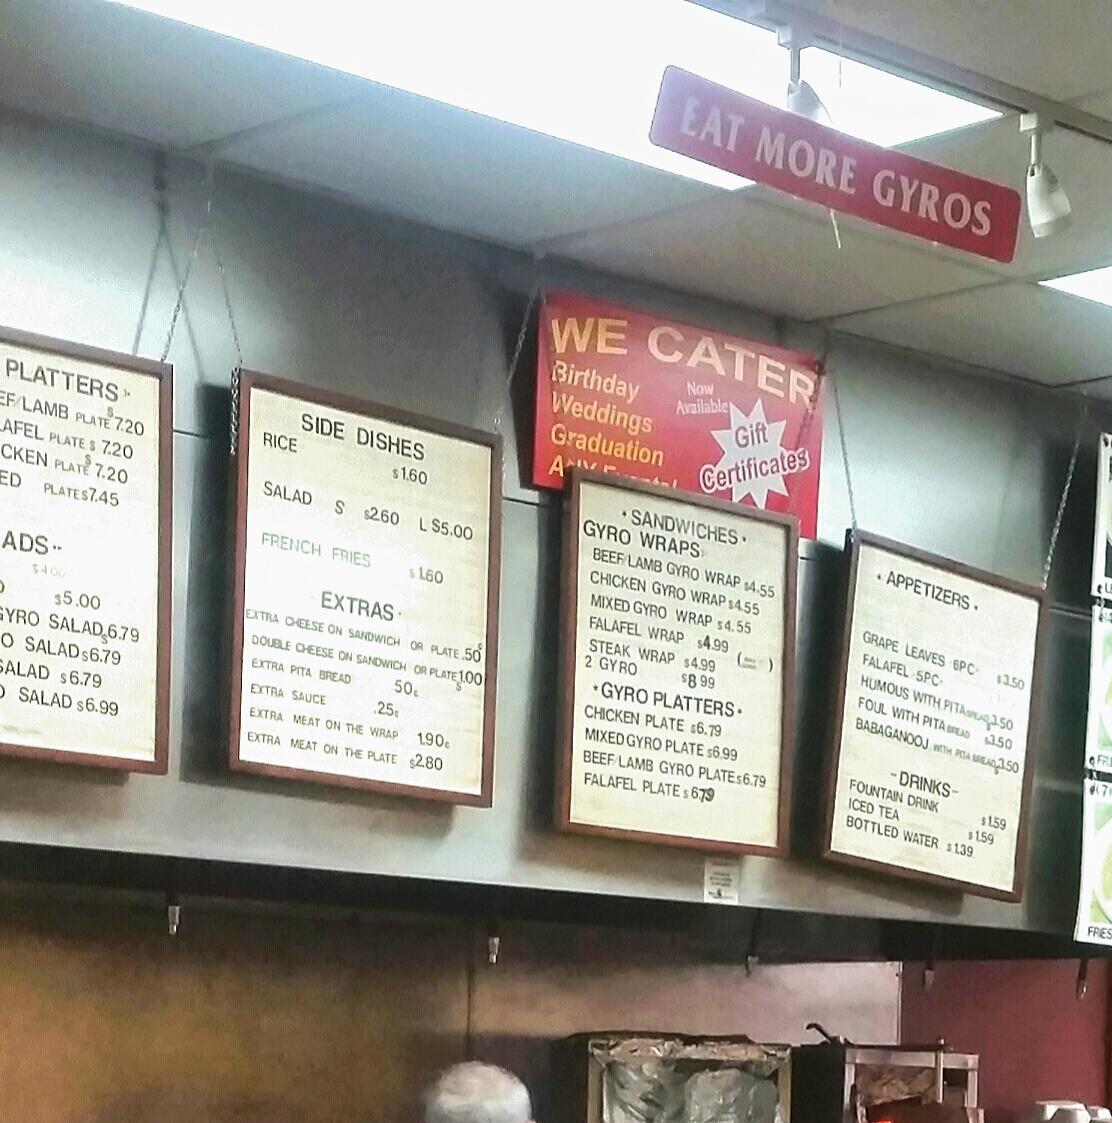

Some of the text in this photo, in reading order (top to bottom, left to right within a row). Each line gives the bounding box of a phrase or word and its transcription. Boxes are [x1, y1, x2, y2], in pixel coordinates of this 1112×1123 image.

[679, 97, 992, 237] EAT MORE GYROS
[551, 318, 819, 406] WE CATER
[6, 358, 118, 402] PLATTERS
[552, 360, 640, 404] Birthday
[687, 382, 714, 395] Now
[552, 392, 652, 434] Weddings
[676, 399, 728, 415] Available
[263, 432, 297, 452] RICE
[302, 414, 424, 460] SIDE DISHES
[550, 423, 664, 466] Graduation
[735, 422, 768, 449] Gift
[701, 448, 809, 491] Certificates
[264, 481, 312, 505] SALAD
[583, 520, 700, 558] GYRO WRAPS
[631, 509, 738, 545] SANDWICHES
[262, 533, 370, 568] FRENCH FRIES
[591, 571, 726, 606] CHICKEN GYRO WRAP
[667, 562, 699, 581] GYRO
[705, 570, 741, 587] WRAP
[887, 571, 970, 610] APPETIZERS
[321, 591, 394, 621] EXTRAS
[591, 594, 712, 627] MIXED GYRO WRAP
[49, 614, 103, 636] SALAD
[246, 609, 459, 659] EXTRA ON SANDWICH PLATE
[590, 617, 684, 644] FALAFEL WRAP
[25, 637, 79, 658] SALAD
[252, 635, 291, 651] DOUBLE
[589, 639, 675, 664] STEAK WRAP
[863, 631, 945, 667] GRAPE LEAVES
[252, 659, 351, 683] EXTRA PITA BREAD
[585, 655, 637, 676] 2 GYRO
[863, 654, 909, 678] FALAFEL
[19, 687, 72, 708] SALAD
[251, 684, 326, 705] EXTRA SAUCE
[601, 682, 734, 717] GYRO PLATTERS
[861, 675, 940, 708] HUMOUS WITH
[250, 707, 398, 739] EXTRA MEAT ON THE WRAP
[585, 705, 684, 732] CHICKEN PLATE
[858, 697, 945, 731] FOUL WITH PITA
[248, 732, 397, 764] EXTRA MEAT ON THE PLATE
[585, 728, 704, 757] MIXED GYRO PLATE
[856, 717, 929, 750] BABAGANOOJ
[584, 773, 680, 797] FALAFEL PLATE
[659, 761, 693, 777] GYRO
[699, 766, 735, 783] PLATE
[900, 771, 951, 798] DRINKS
[849, 797, 899, 821] ICED TEA
[850, 779, 939, 813] FOUNTAIN DRINK
[847, 815, 939, 849] BOTTLED WATER
